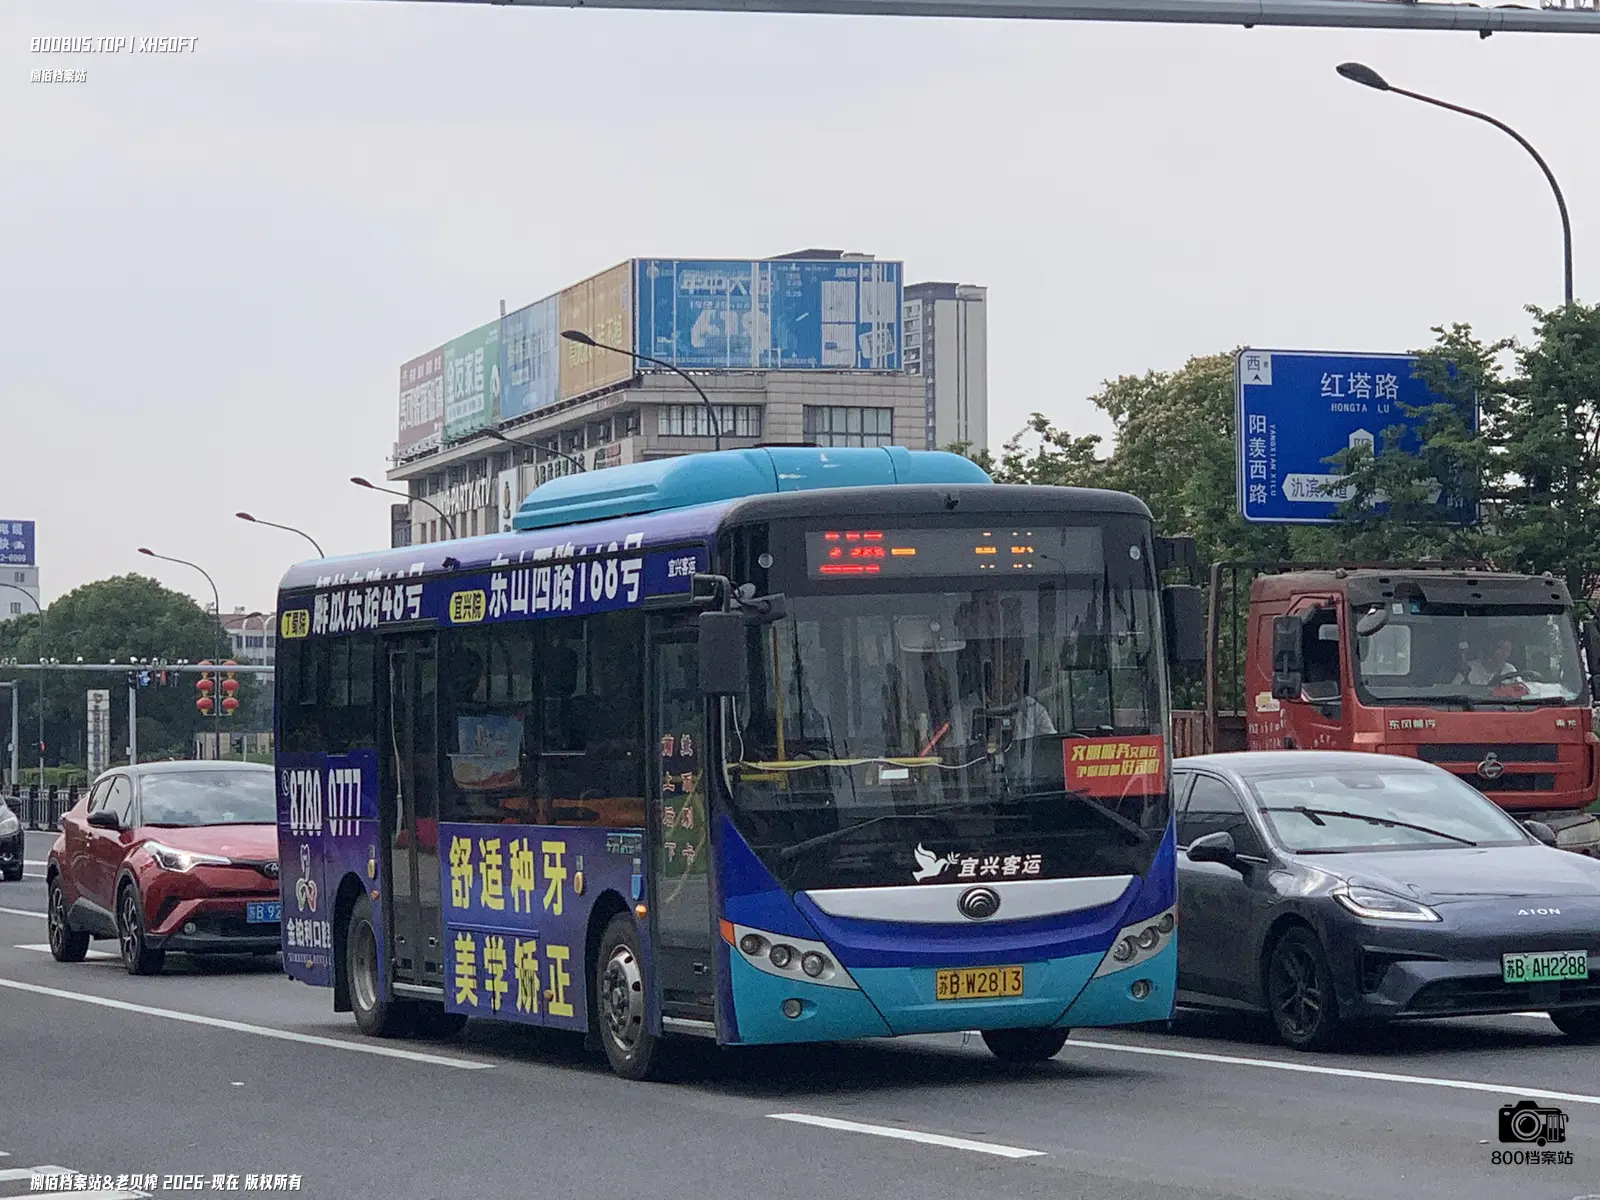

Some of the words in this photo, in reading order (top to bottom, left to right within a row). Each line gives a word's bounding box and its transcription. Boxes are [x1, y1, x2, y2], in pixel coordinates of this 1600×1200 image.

[1246, 355, 1261, 372] 西
[1320, 372, 1399, 400] 红塔路
[1331, 403, 1367, 413] HONGTA
[1378, 403, 1390, 413] LU
[1249, 415, 1268, 504] 阳羡西路
[668, 556, 696, 578] 宜兴客运
[453, 592, 482, 620] 宜兴院
[290, 769, 322, 836] 8780
[328, 768, 361, 836] 0777
[449, 835, 567, 916] 舒适种牙
[957, 854, 1043, 877] 宜兴客运
[1518, 908, 1561, 916] AION
[454, 932, 574, 1017] 美学矫正
